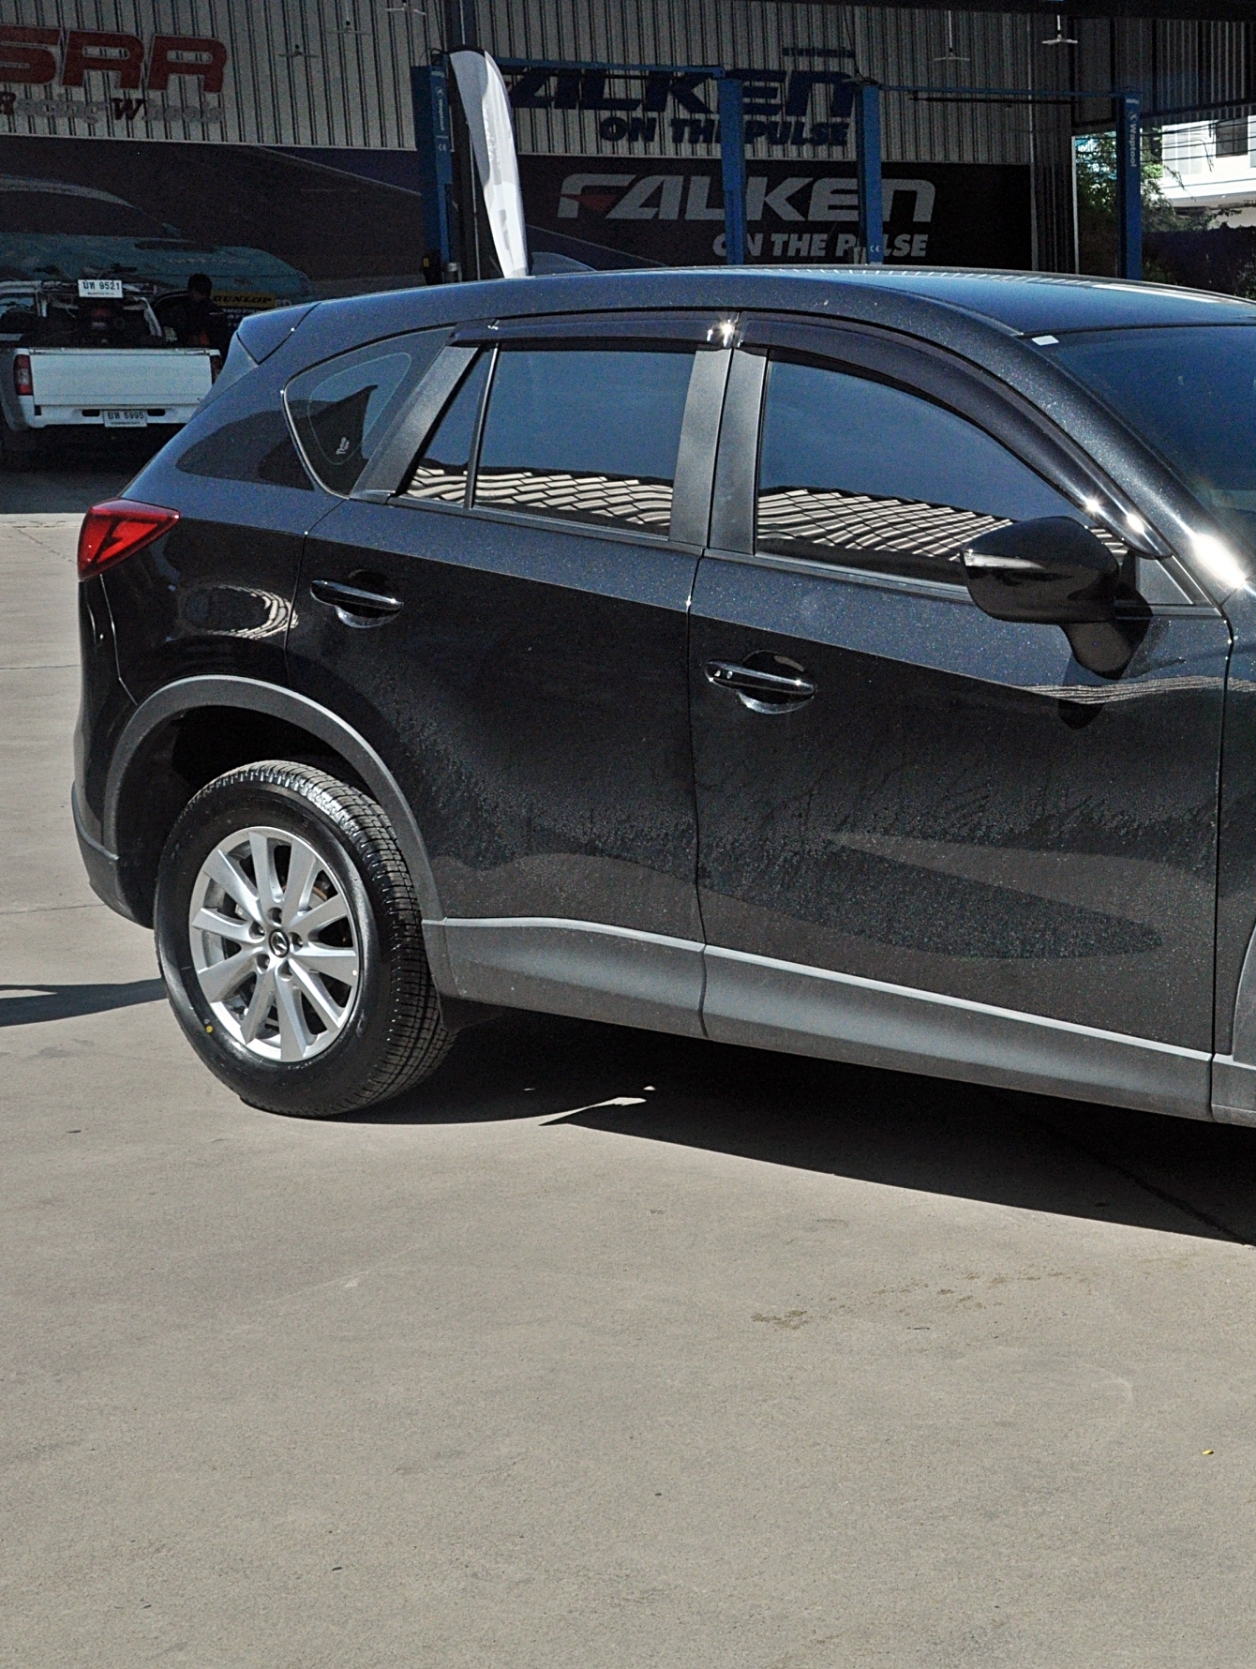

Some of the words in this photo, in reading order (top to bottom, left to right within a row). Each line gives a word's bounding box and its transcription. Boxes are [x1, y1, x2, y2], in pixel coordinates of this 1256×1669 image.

[502, 64, 858, 117] ALKEN
[600, 116, 658, 143] ON
[743, 120, 850, 147] PULSE
[556, 173, 937, 224] FALKEN
[769, 233, 830, 258] THE
[834, 233, 929, 259] PLSE
